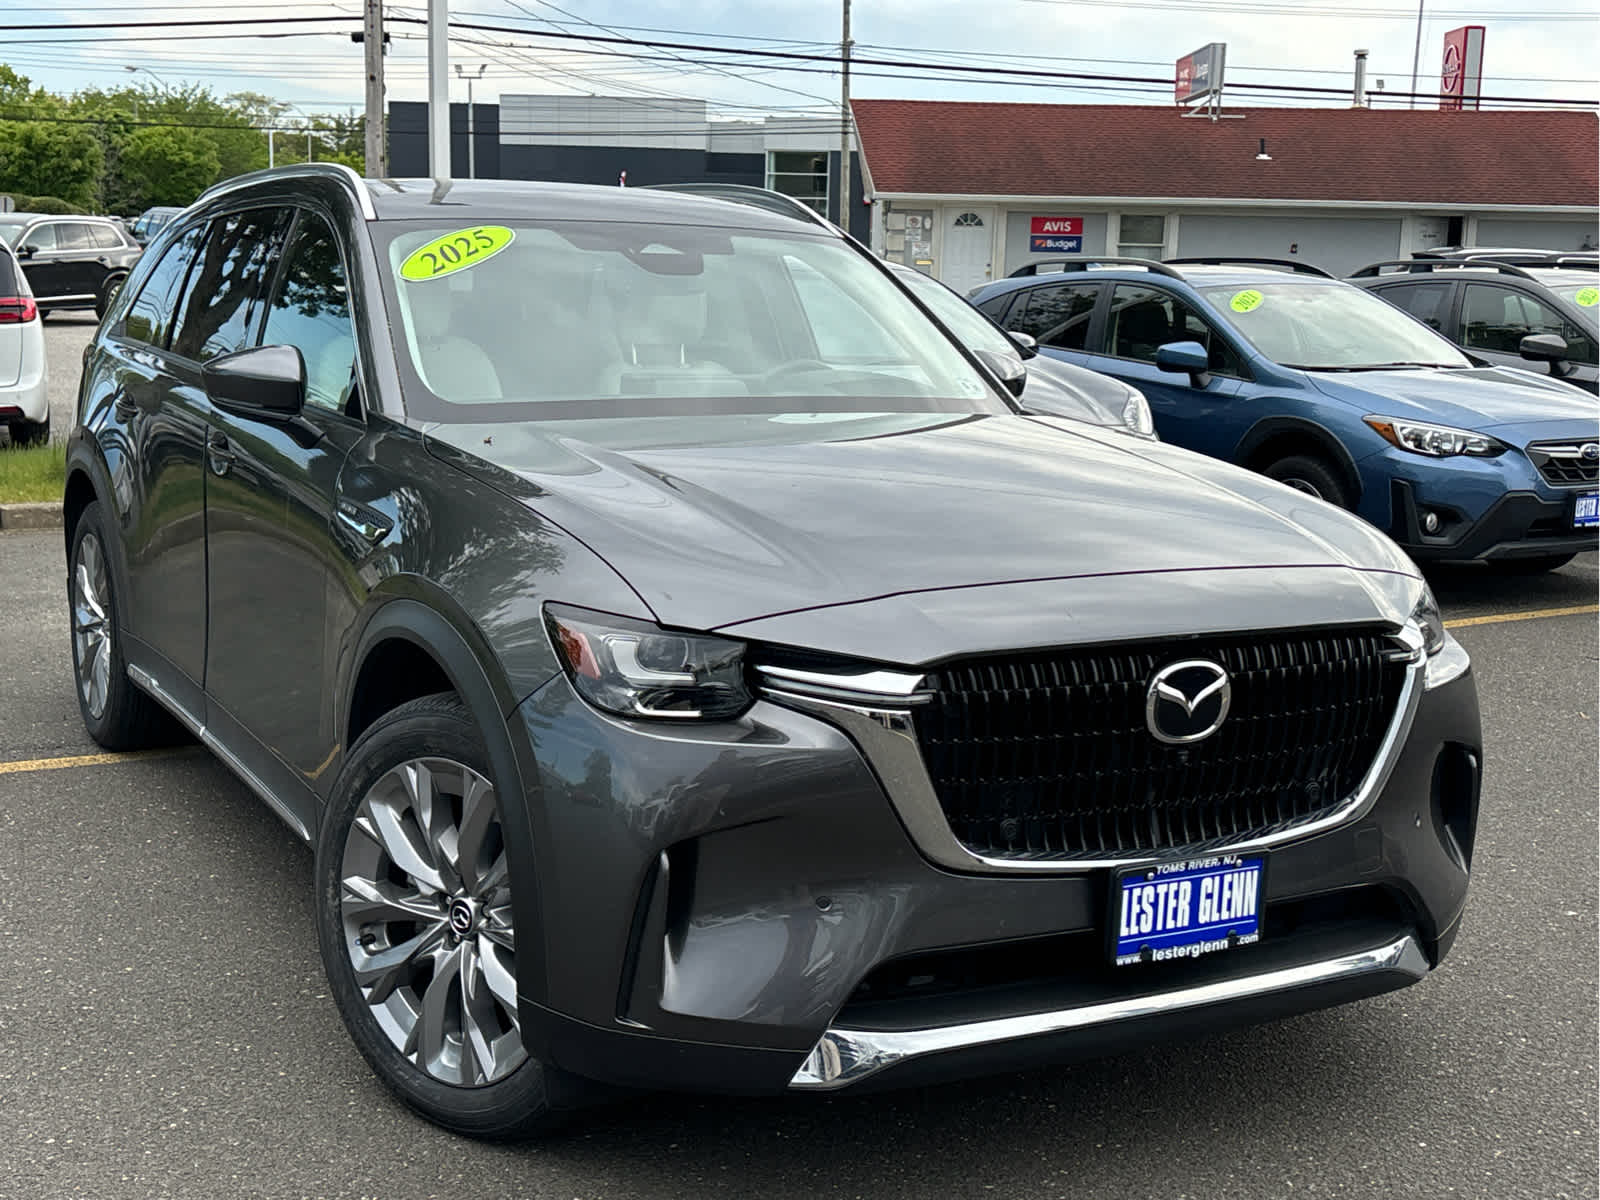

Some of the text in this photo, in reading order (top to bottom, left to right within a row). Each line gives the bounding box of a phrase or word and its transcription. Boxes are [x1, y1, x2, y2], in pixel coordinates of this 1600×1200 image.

[1042, 221, 1072, 232] AVIS
[420, 229, 495, 275] 2025
[1046, 239, 1078, 250] Budget
[1156, 862, 1186, 875] TOMS
[1223, 855, 1238, 865] NJ
[1119, 870, 1259, 937] LESTER GLENN
[1152, 939, 1229, 962] lesterglenn
